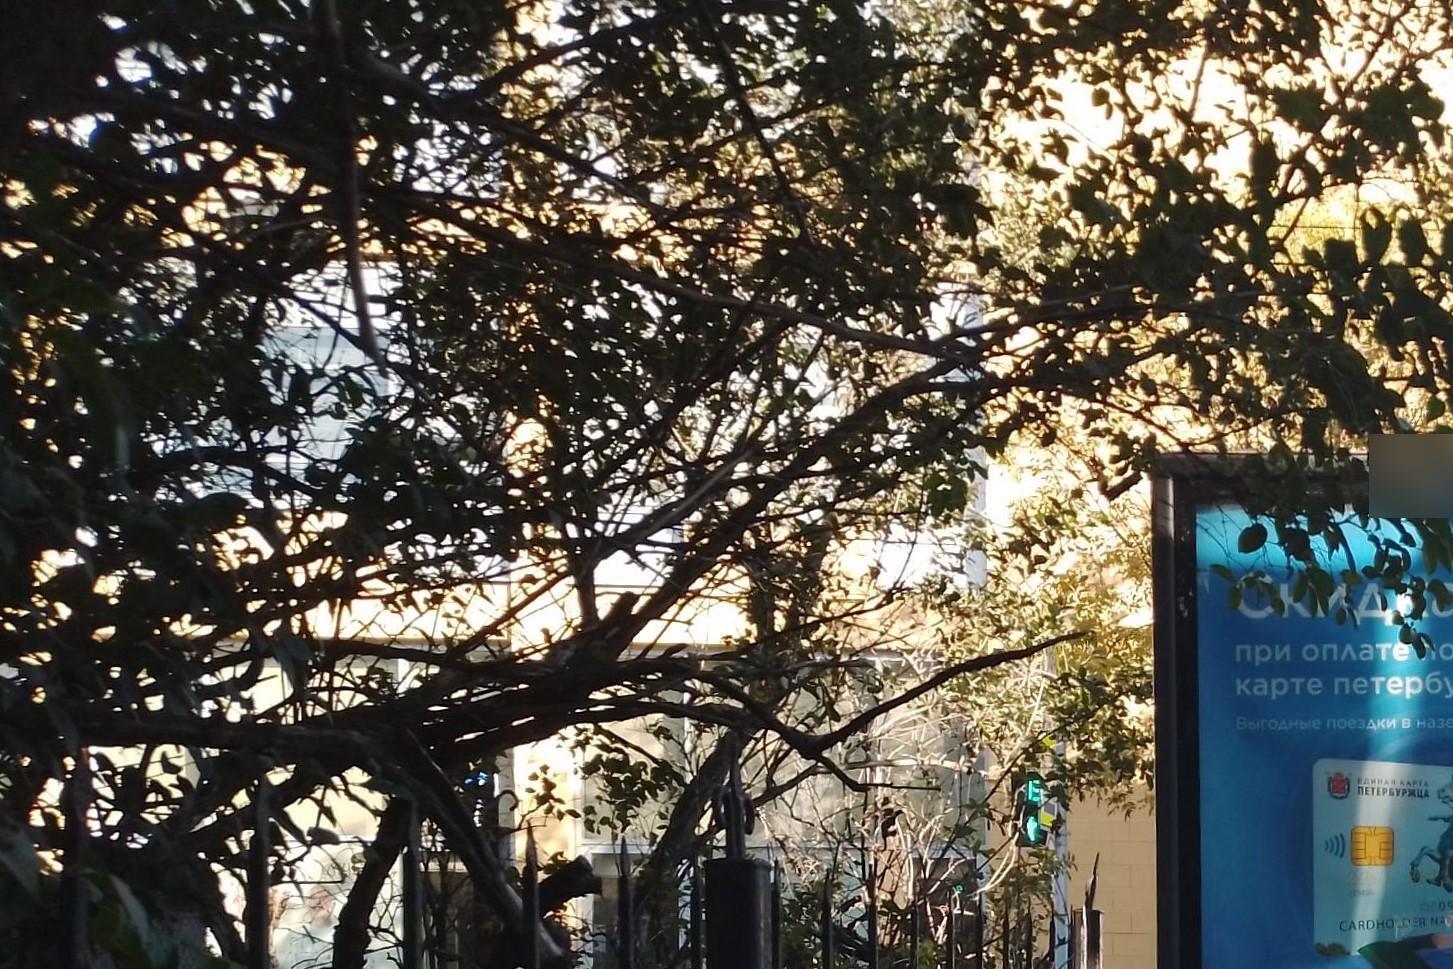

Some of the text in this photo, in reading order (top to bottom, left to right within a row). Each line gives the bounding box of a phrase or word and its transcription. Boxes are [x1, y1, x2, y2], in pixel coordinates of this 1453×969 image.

[1235, 643, 1291, 667] при
[1302, 641, 1410, 662] оплате
[1236, 677, 1322, 698] карте
[1235, 716, 1321, 732] Выгодные
[1327, 717, 1396, 731] поездки
[1402, 717, 1411, 729] в
[1357, 785, 1430, 799] ПЕТЕРБУРЖЦА
